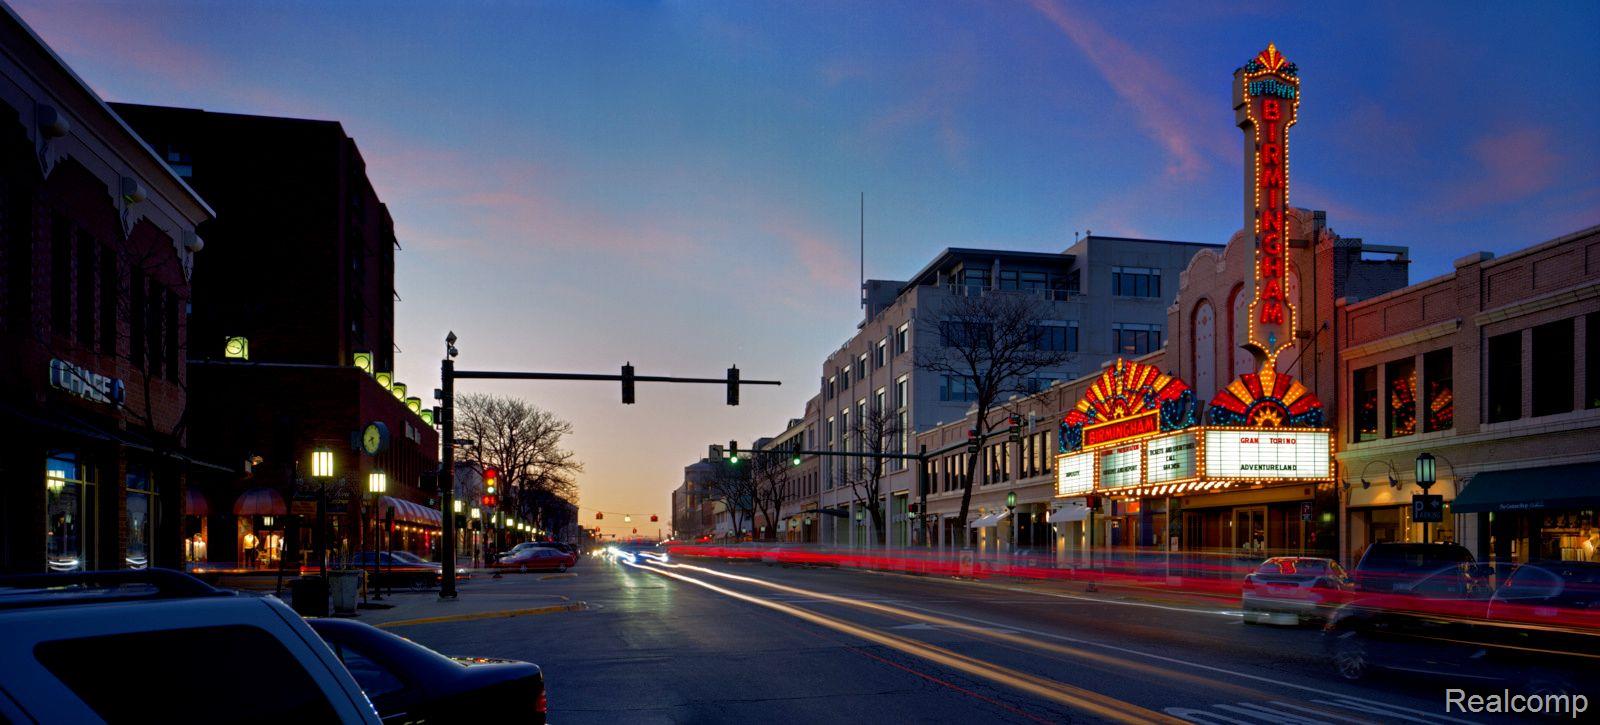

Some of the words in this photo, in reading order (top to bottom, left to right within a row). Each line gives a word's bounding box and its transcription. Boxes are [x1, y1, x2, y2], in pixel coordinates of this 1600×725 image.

[1249, 80, 1295, 99] UPTOWN
[1261, 100, 1284, 325] BIRMINGHAM
[55, 359, 111, 403] CHASE
[1088, 415, 1155, 445] BIRMINGHAM
